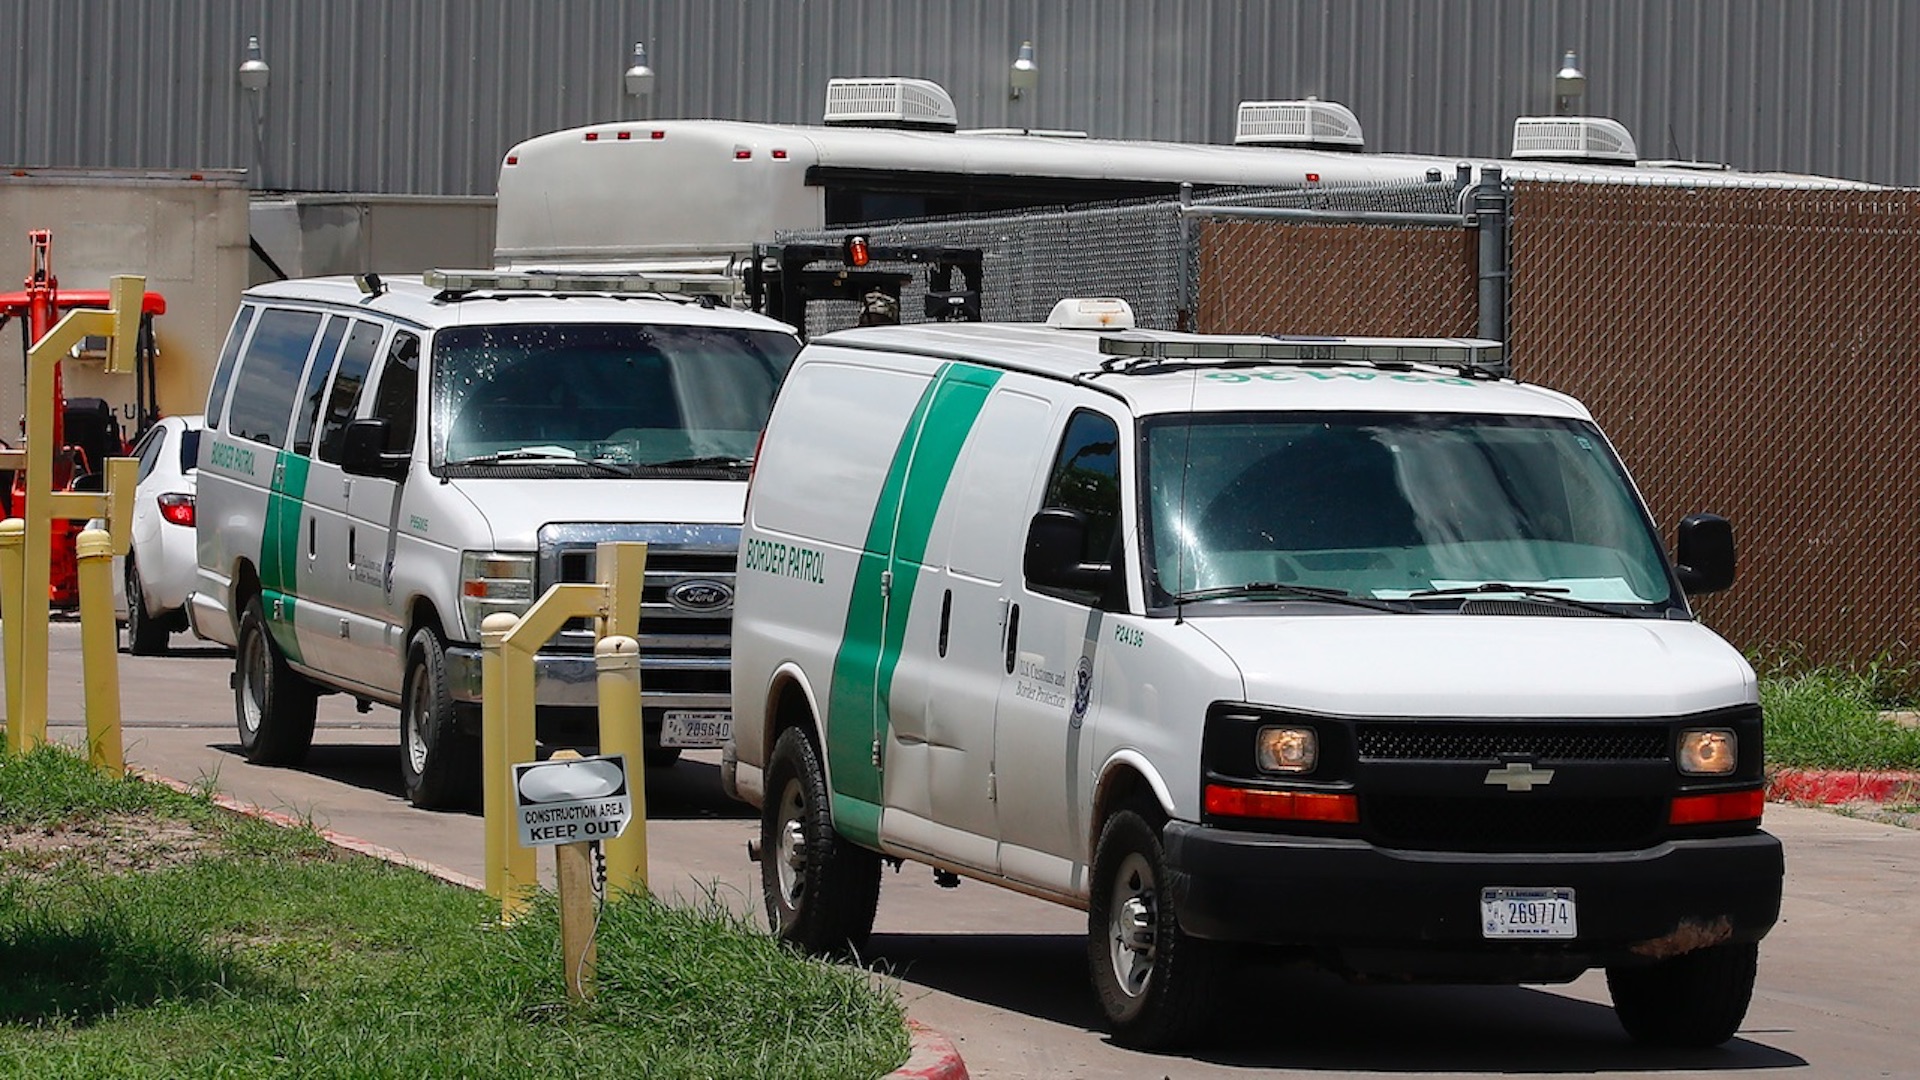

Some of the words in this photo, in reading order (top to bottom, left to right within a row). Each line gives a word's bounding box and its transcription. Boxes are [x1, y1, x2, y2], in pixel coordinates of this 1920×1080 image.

[211, 441, 234, 469] BORDER
[234, 448, 255, 476] PATROL
[746, 538, 786, 576] BORDER
[787, 546, 825, 584] PATROL
[687, 588, 718, 602] Ford
[1114, 624, 1144, 647] P24136
[1031, 663, 1053, 684] Customs
[1054, 670, 1066, 687] and
[1016, 680, 1036, 700] Border
[1036, 686, 1066, 708] Protection
[525, 805, 597, 824] CONSTRUCTION
[599, 802, 625, 816] AREA
[530, 824, 578, 840] KEEP
[584, 820, 621, 835] OUT
[1508, 902, 1568, 924] 269774
